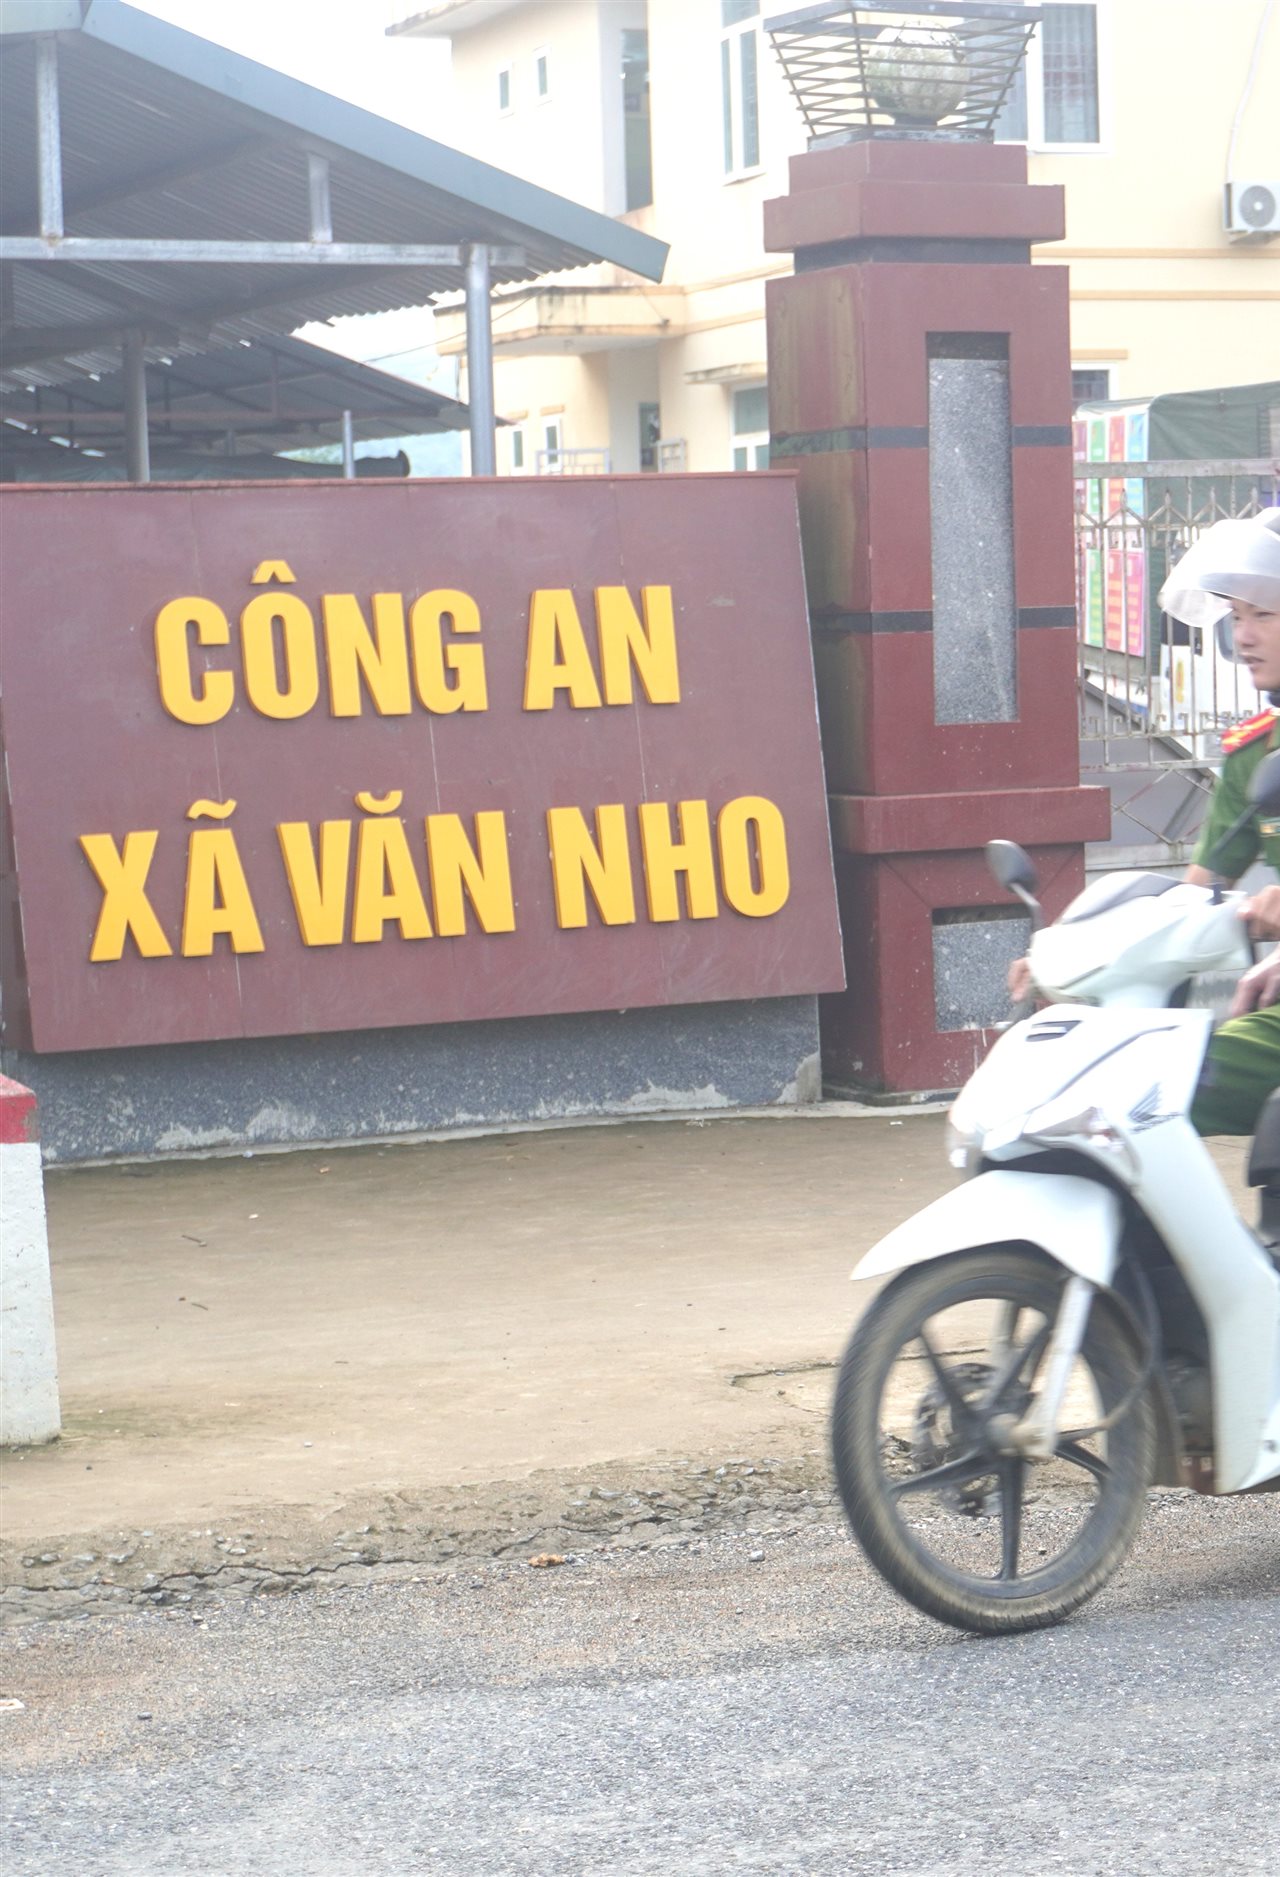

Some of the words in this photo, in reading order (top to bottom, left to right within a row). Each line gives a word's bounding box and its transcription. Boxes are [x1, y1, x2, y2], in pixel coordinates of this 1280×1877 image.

[154, 559, 488, 726] CÔNG
[523, 585, 682, 712] AN
[79, 799, 266, 962] XÃ
[277, 790, 516, 948] VĂN
[547, 795, 791, 930] NHO
